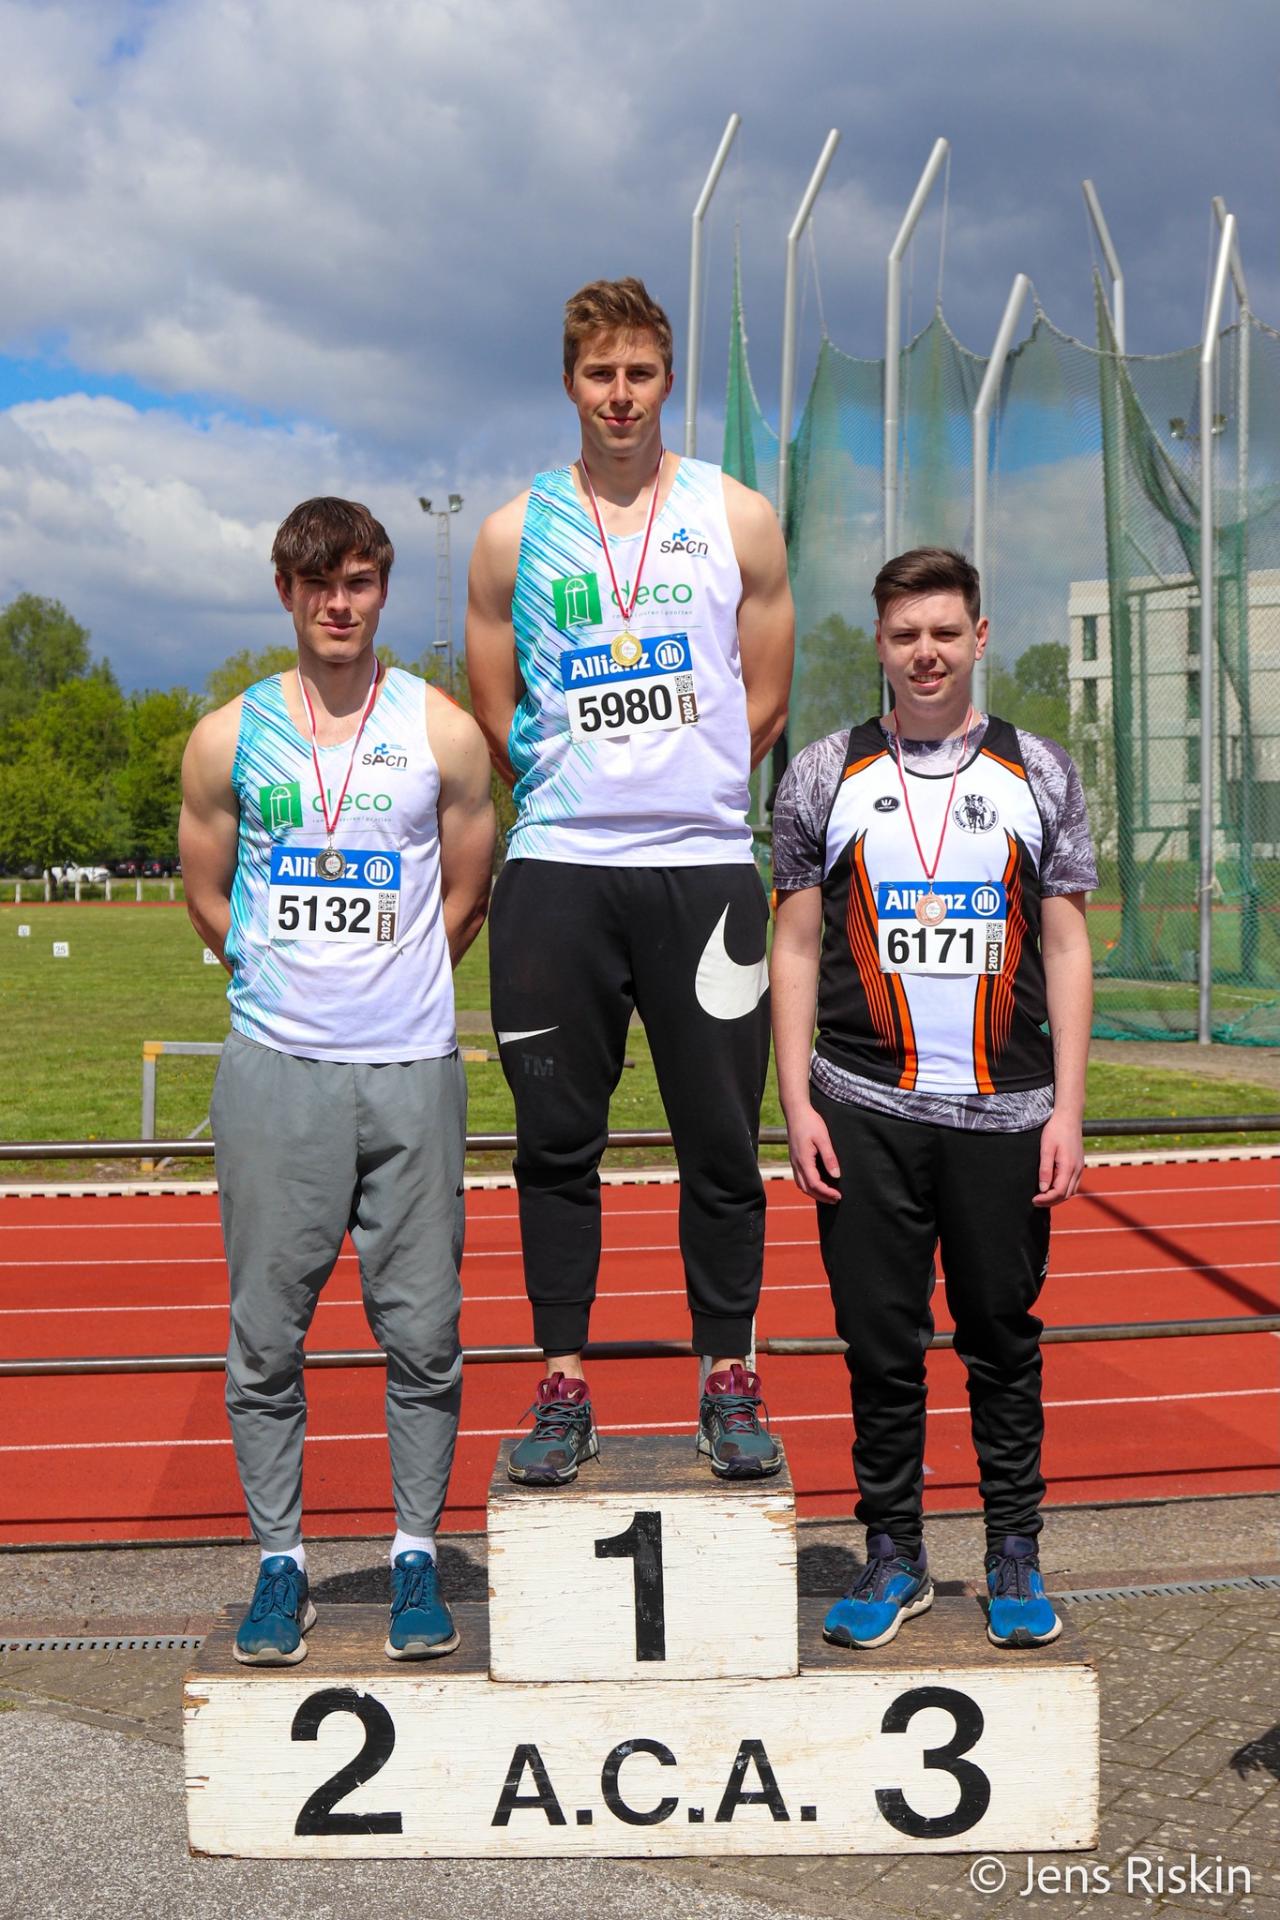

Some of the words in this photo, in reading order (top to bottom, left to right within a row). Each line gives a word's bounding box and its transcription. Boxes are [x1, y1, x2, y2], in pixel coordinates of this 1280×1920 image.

[611, 580, 692, 607] deco
[571, 652, 651, 680] Alliaz
[579, 685, 671, 732] 5980
[681, 695, 694, 722] 2024
[312, 789, 392, 813] deco
[278, 856, 358, 879] Alliz
[279, 895, 370, 933] 5132
[885, 889, 966, 911] Allinz
[381, 913, 391, 940] 2024
[888, 928, 973, 964] 6171
[988, 943, 999, 970] 2024
[595, 1511, 665, 1661] 1
[291, 1688, 402, 1835] 2
[875, 1687, 990, 1839] 3
[491, 1739, 817, 1827] A.C.A.
